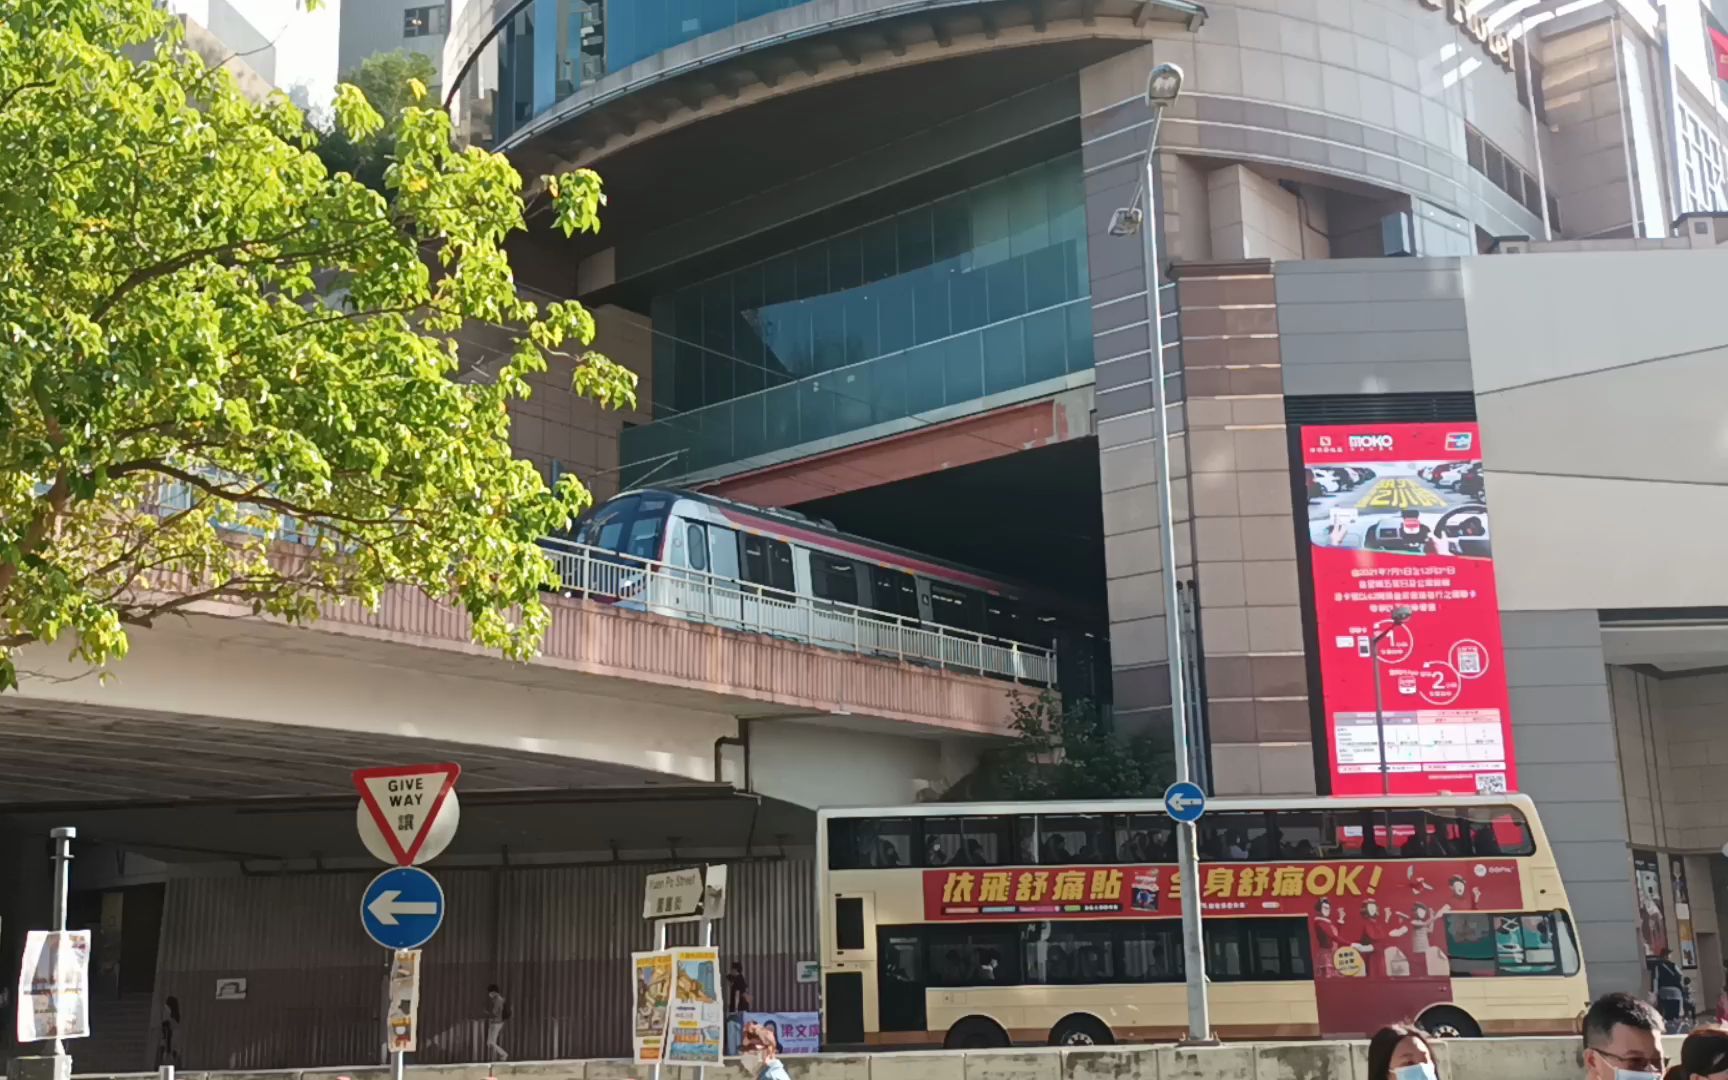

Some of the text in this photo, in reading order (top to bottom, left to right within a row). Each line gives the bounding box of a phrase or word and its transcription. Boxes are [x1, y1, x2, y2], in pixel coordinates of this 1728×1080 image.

[388, 777, 424, 792] GIVE
[389, 793, 424, 807] WAY
[398, 813, 415, 831] 讓
